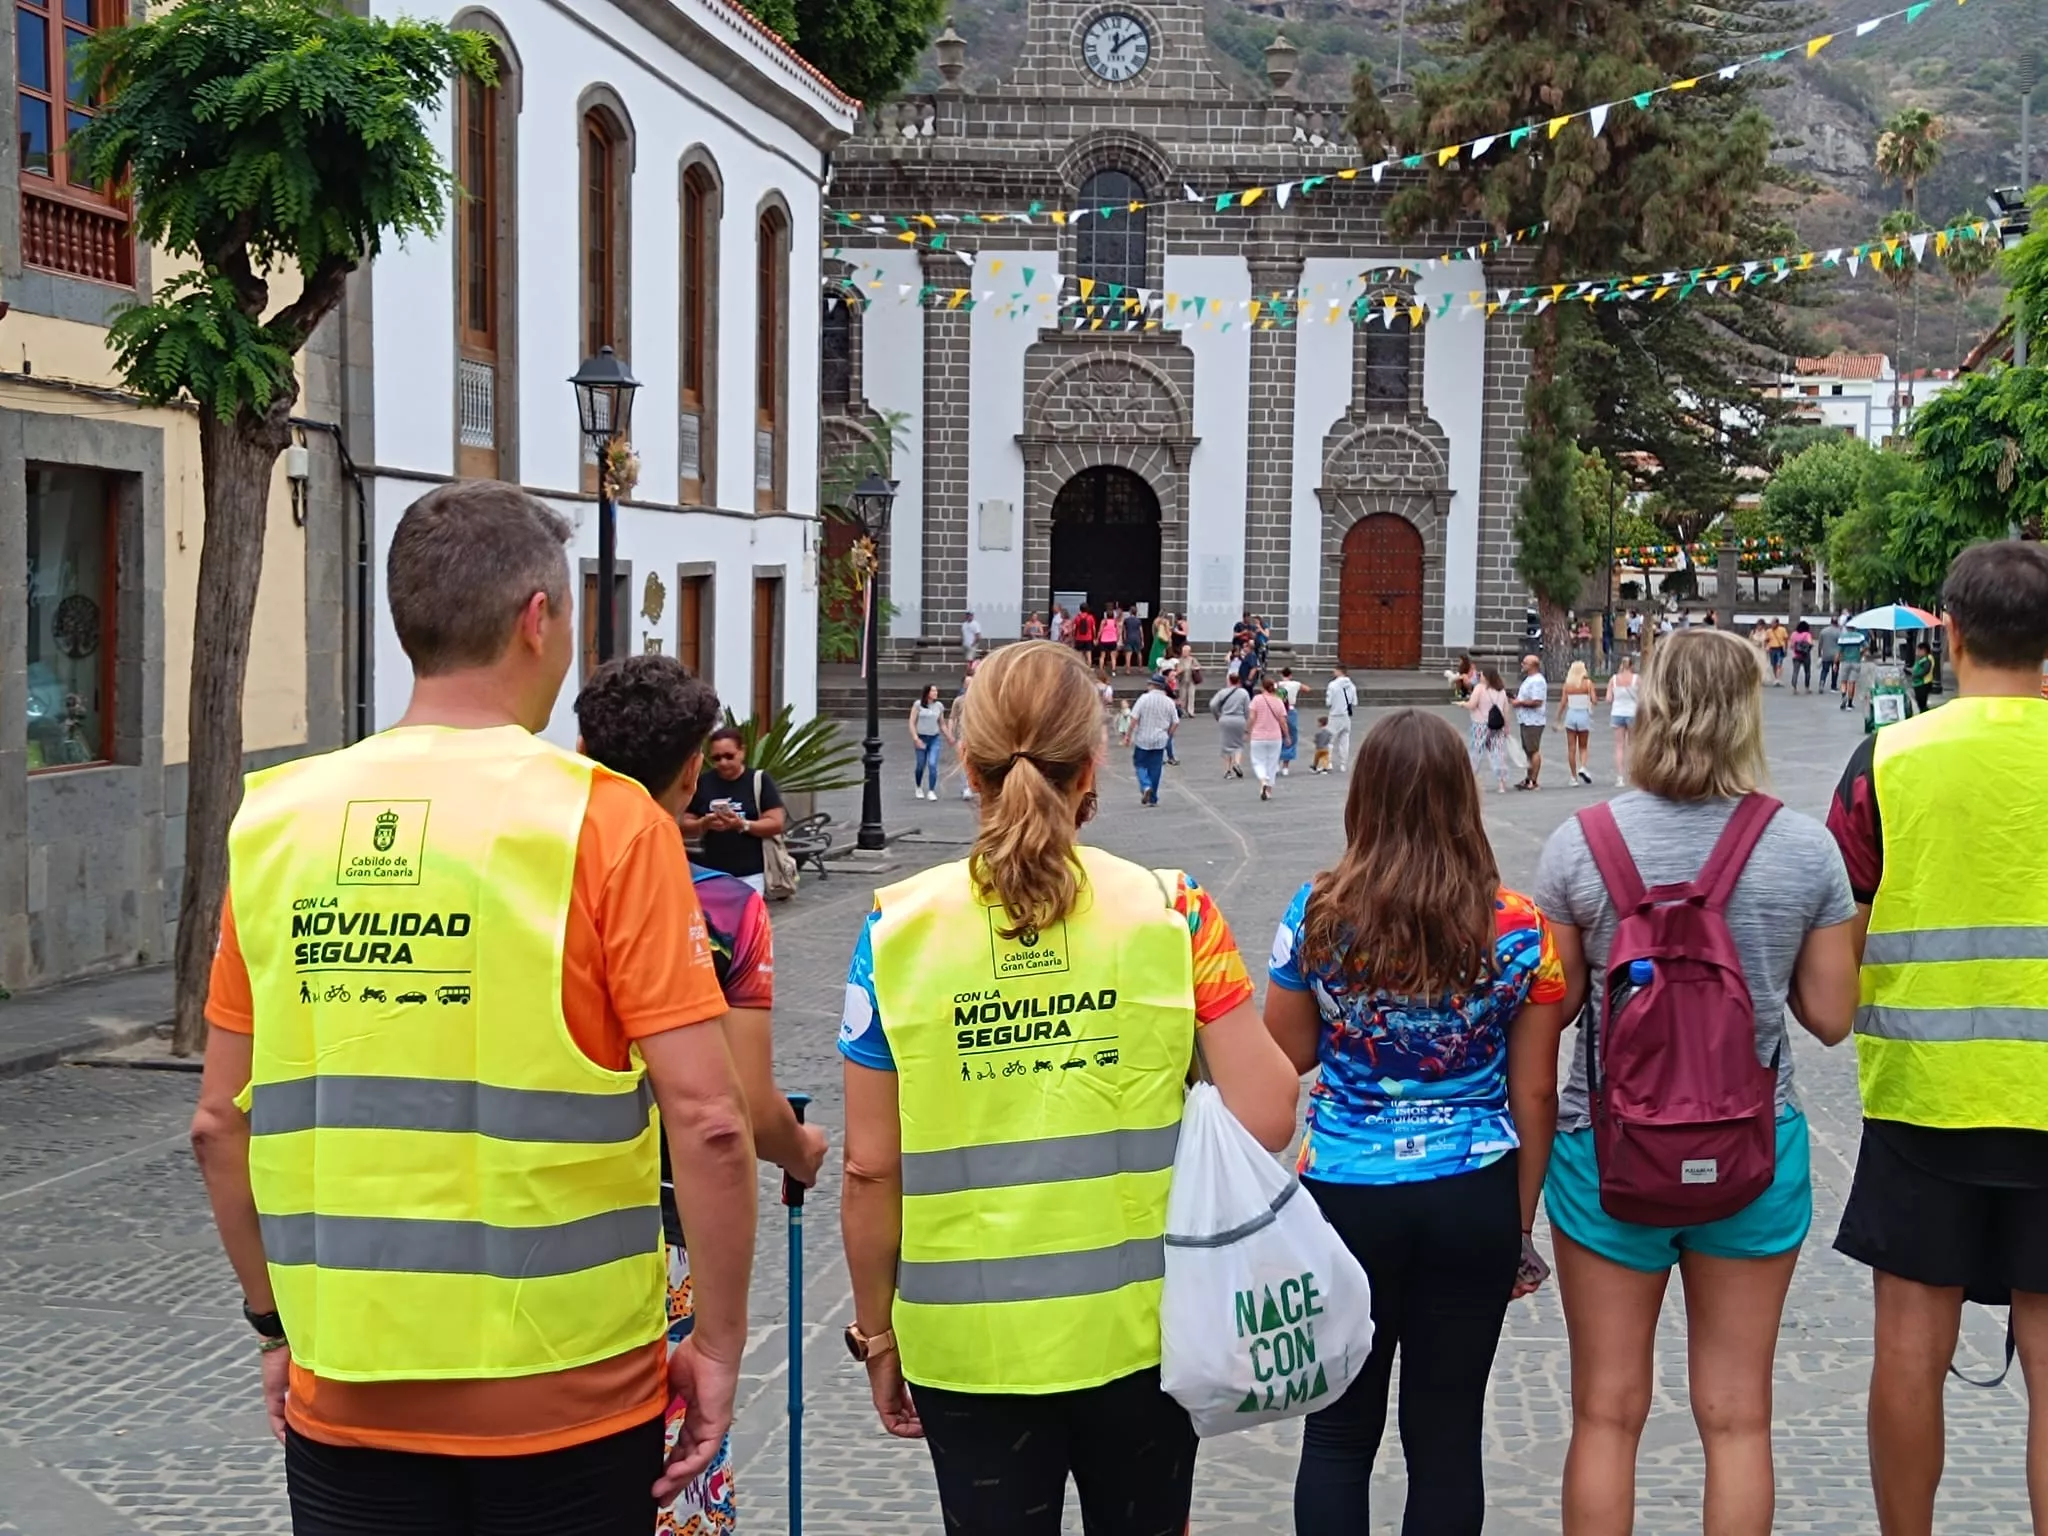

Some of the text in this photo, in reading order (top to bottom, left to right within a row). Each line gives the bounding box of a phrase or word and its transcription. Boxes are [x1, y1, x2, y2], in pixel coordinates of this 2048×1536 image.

[352, 856, 408, 867] Cabildo de
[345, 867, 413, 878] Gran Canaria
[292, 897, 338, 911] CON LA
[292, 912, 471, 938] MOVILIDAD
[295, 941, 414, 966] SEGURA
[1004, 949, 1055, 963] Cabildo de
[1001, 957, 1062, 972] Gran Canaria
[953, 989, 1001, 1004] CON LA
[954, 989, 1117, 1027] MOVILIDAD
[957, 1019, 1072, 1049] SEGURA
[1250, 1321, 1316, 1382] CON
